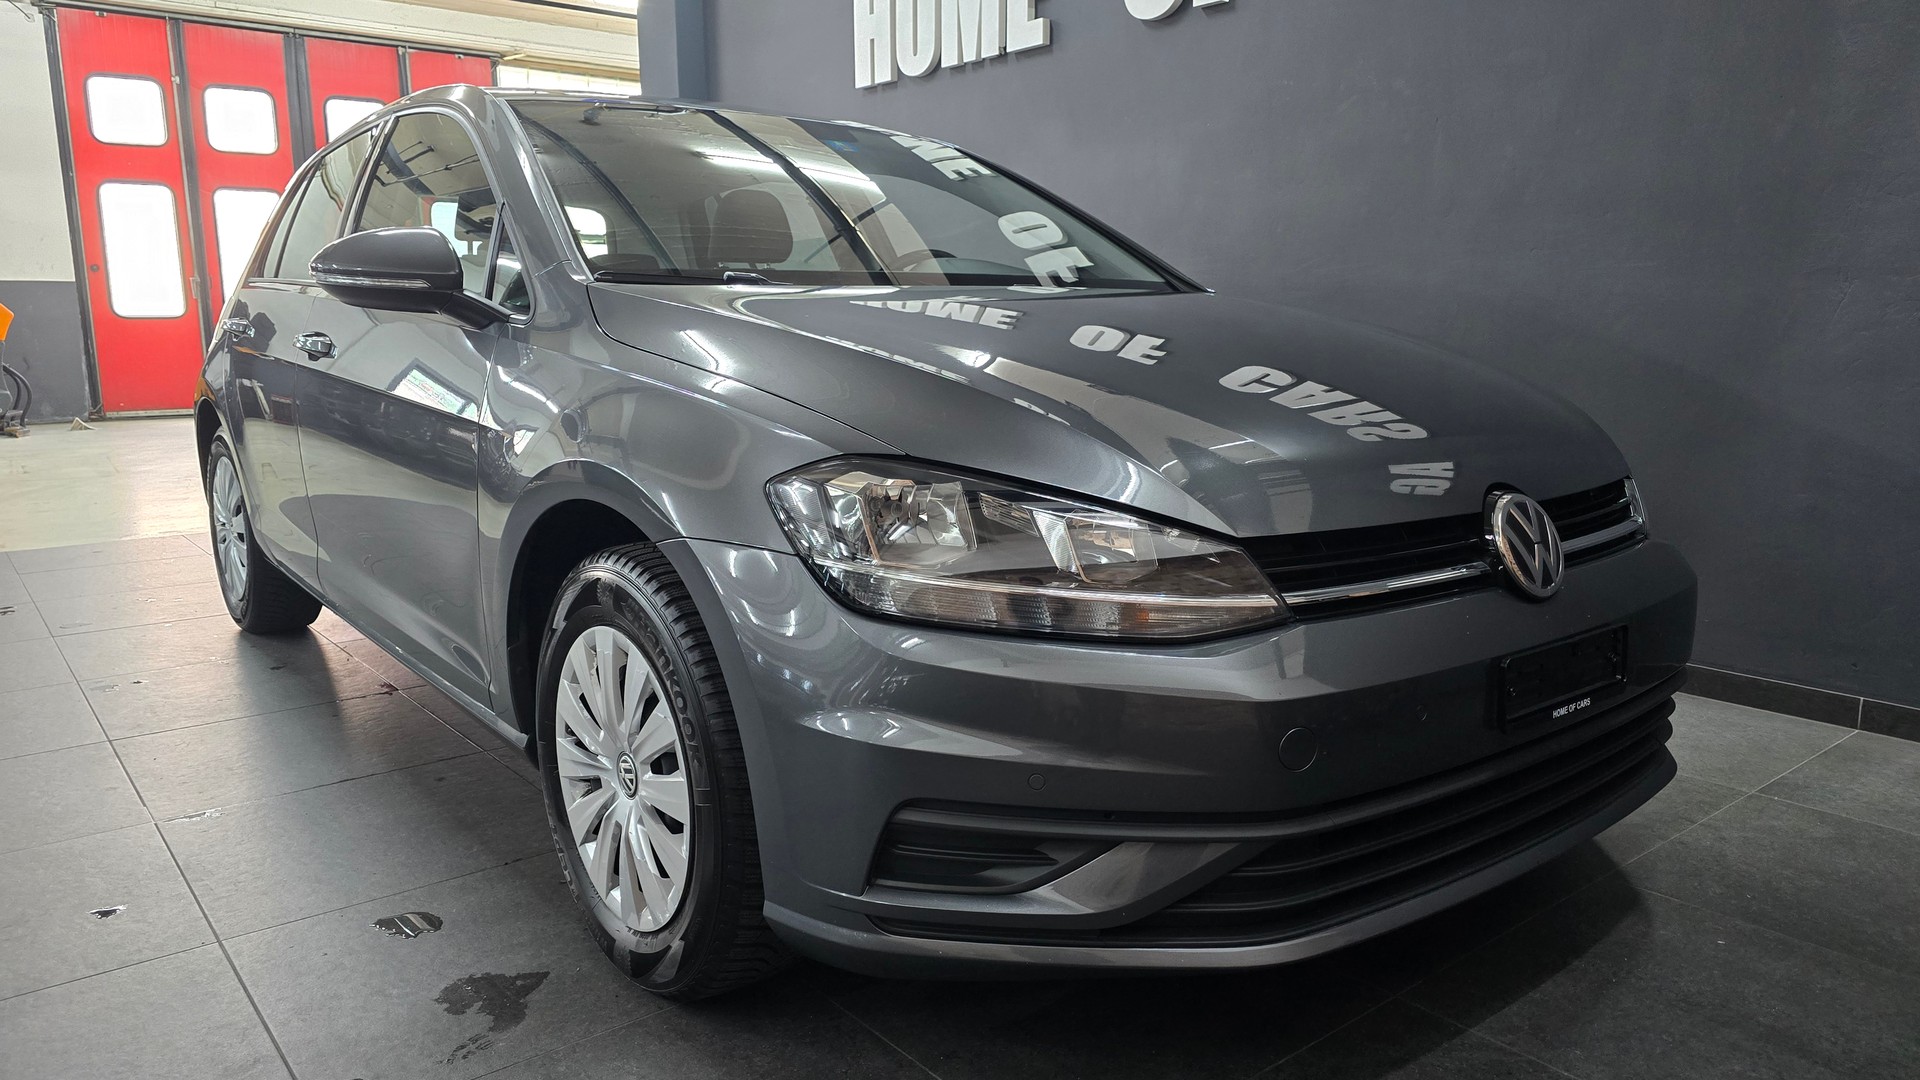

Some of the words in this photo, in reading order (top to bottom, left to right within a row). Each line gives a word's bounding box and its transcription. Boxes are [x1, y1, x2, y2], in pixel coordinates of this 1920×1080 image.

[1552, 705, 1568, 719] HOME
[1568, 702, 1577, 713] OF
[1576, 697, 1591, 710] CARS
